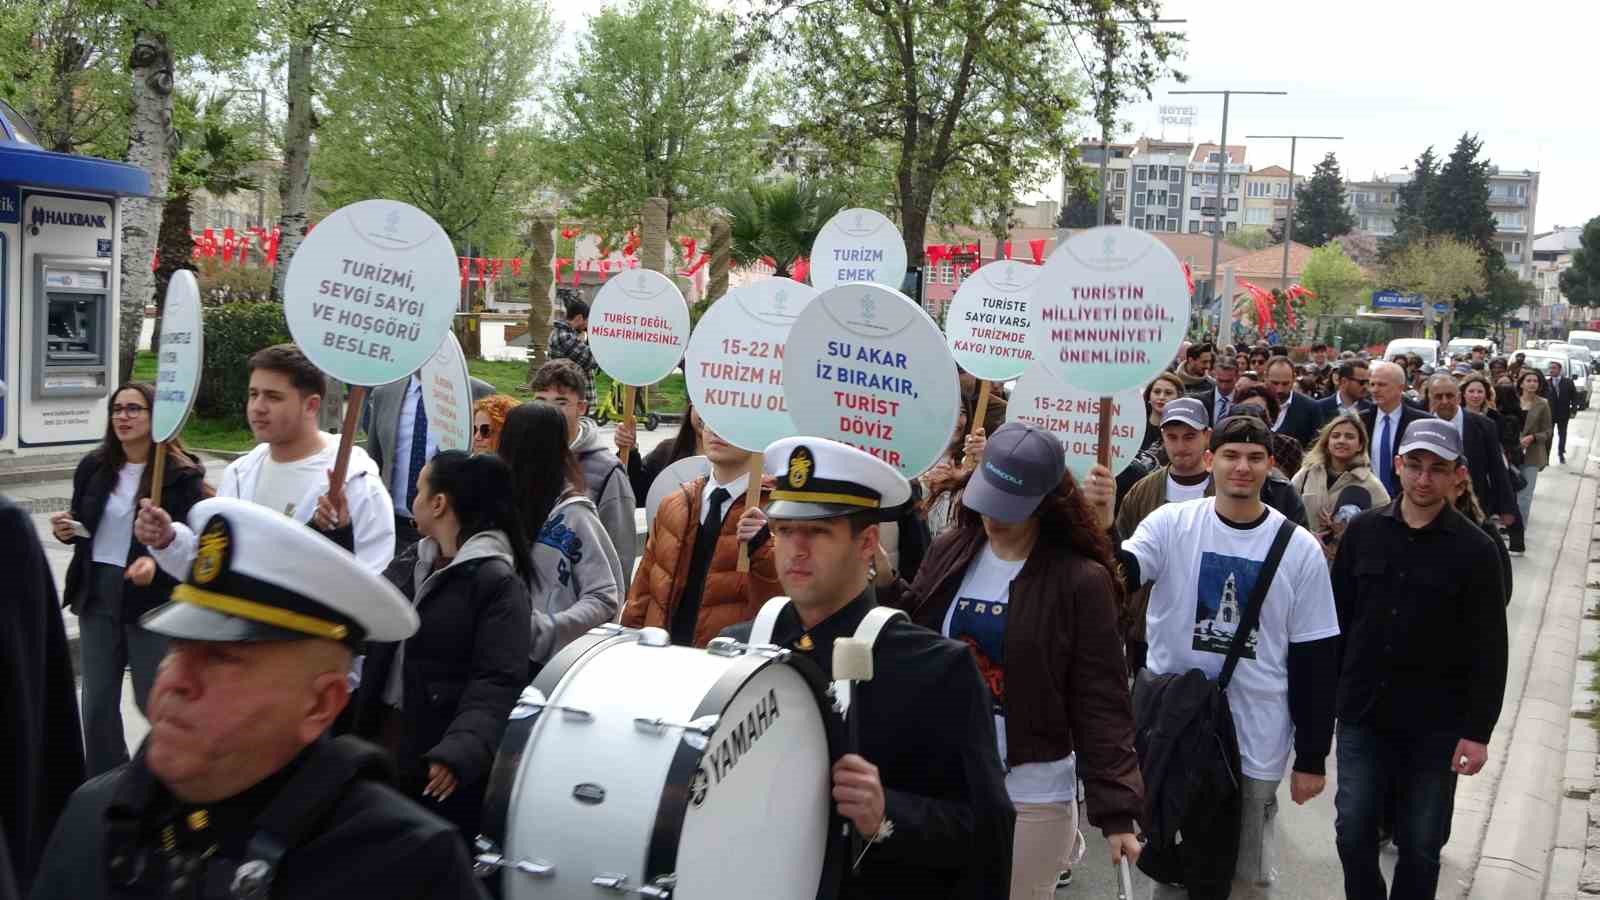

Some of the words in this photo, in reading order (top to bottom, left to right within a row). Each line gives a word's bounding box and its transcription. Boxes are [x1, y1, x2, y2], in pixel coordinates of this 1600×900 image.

[0, 196, 14, 212] ik
[46, 210, 107, 228] HALKBANK
[833, 246, 883, 262] TURİZM
[342, 259, 415, 292] TURİZMİ,
[838, 268, 875, 281] EMEK
[319, 280, 372, 304] SEVGİ
[374, 293, 424, 317] SAYGI
[1072, 283, 1144, 300] TURİSTİN
[982, 297, 1027, 312] TURİSTE
[1042, 304, 1118, 321] MİLLİYETİ
[1122, 304, 1174, 323] DEĞİL,
[312, 302, 335, 321] VE
[338, 310, 421, 342] HOŞGÖRÜ
[603, 312, 639, 326] TURİST
[640, 315, 673, 331] DEĞİL,
[965, 312, 996, 324] SAYGI
[971, 327, 1026, 343] TURİZMDE
[1051, 325, 1162, 342] MEMNUNİYETİ
[323, 331, 395, 362] BESLER.
[721, 338, 769, 358] 15-22
[773, 343, 785, 359] N
[827, 341, 851, 359] SU
[856, 346, 907, 369] AKAR
[954, 340, 987, 353] KAYGI
[990, 344, 1035, 360] YOKTUR.
[1060, 346, 1151, 364] ÖNEMLİDİR.
[700, 361, 764, 383] TURİZM
[768, 369, 785, 386] H
[816, 360, 832, 380] İZ
[837, 367, 918, 400] BIRAKIR,
[705, 388, 762, 409] KUTLU
[767, 395, 789, 412] OL
[834, 391, 899, 417] TURİST
[1034, 397, 1072, 412] 15-22
[1076, 398, 1120, 416] NİSN
[840, 416, 892, 440] DÖVİZ
[1072, 441, 1125, 458] OLSN.
[959, 601, 1003, 615] TRO
[710, 687, 780, 784] YAMAHA
